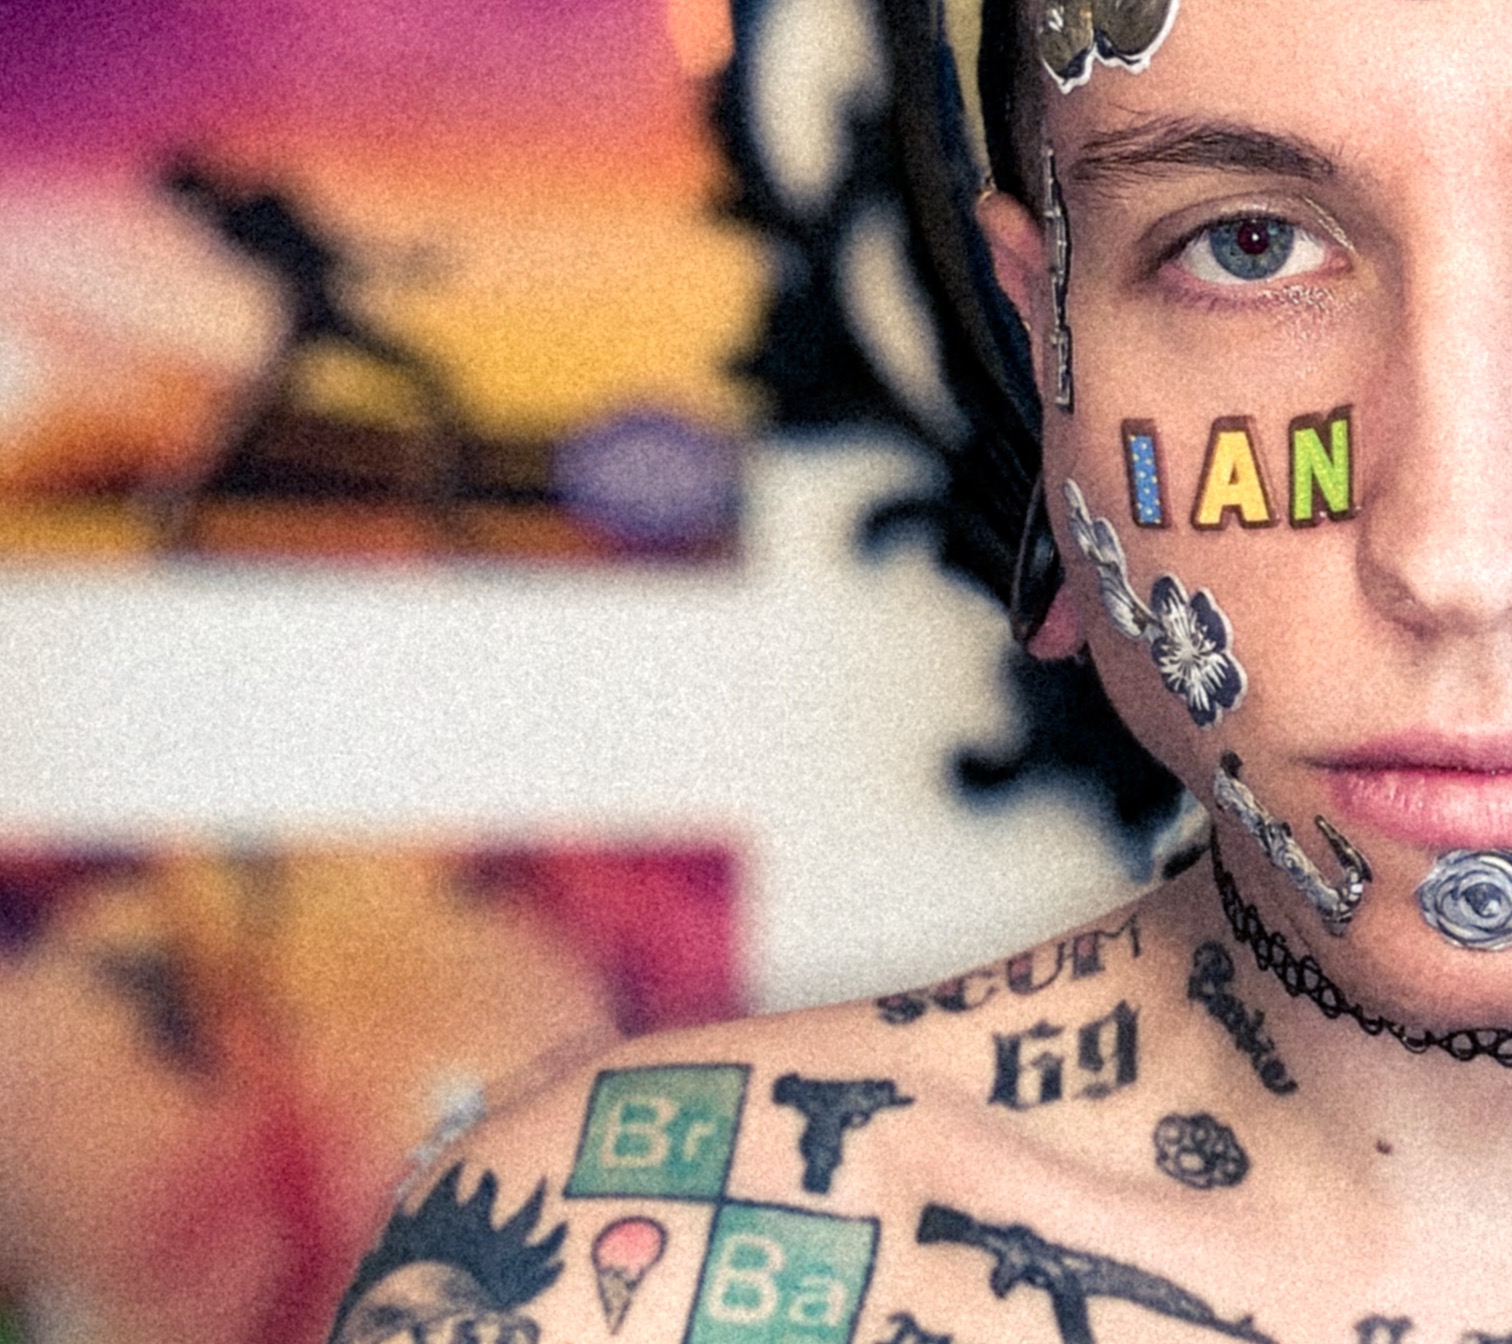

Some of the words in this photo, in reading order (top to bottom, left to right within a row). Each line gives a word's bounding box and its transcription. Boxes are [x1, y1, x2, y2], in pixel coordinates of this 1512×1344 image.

[1121, 404, 1355, 531] IAN
[988, 999, 1140, 1111] 69
[602, 1095, 717, 1167] Br
[706, 1233, 846, 1326] Ba
